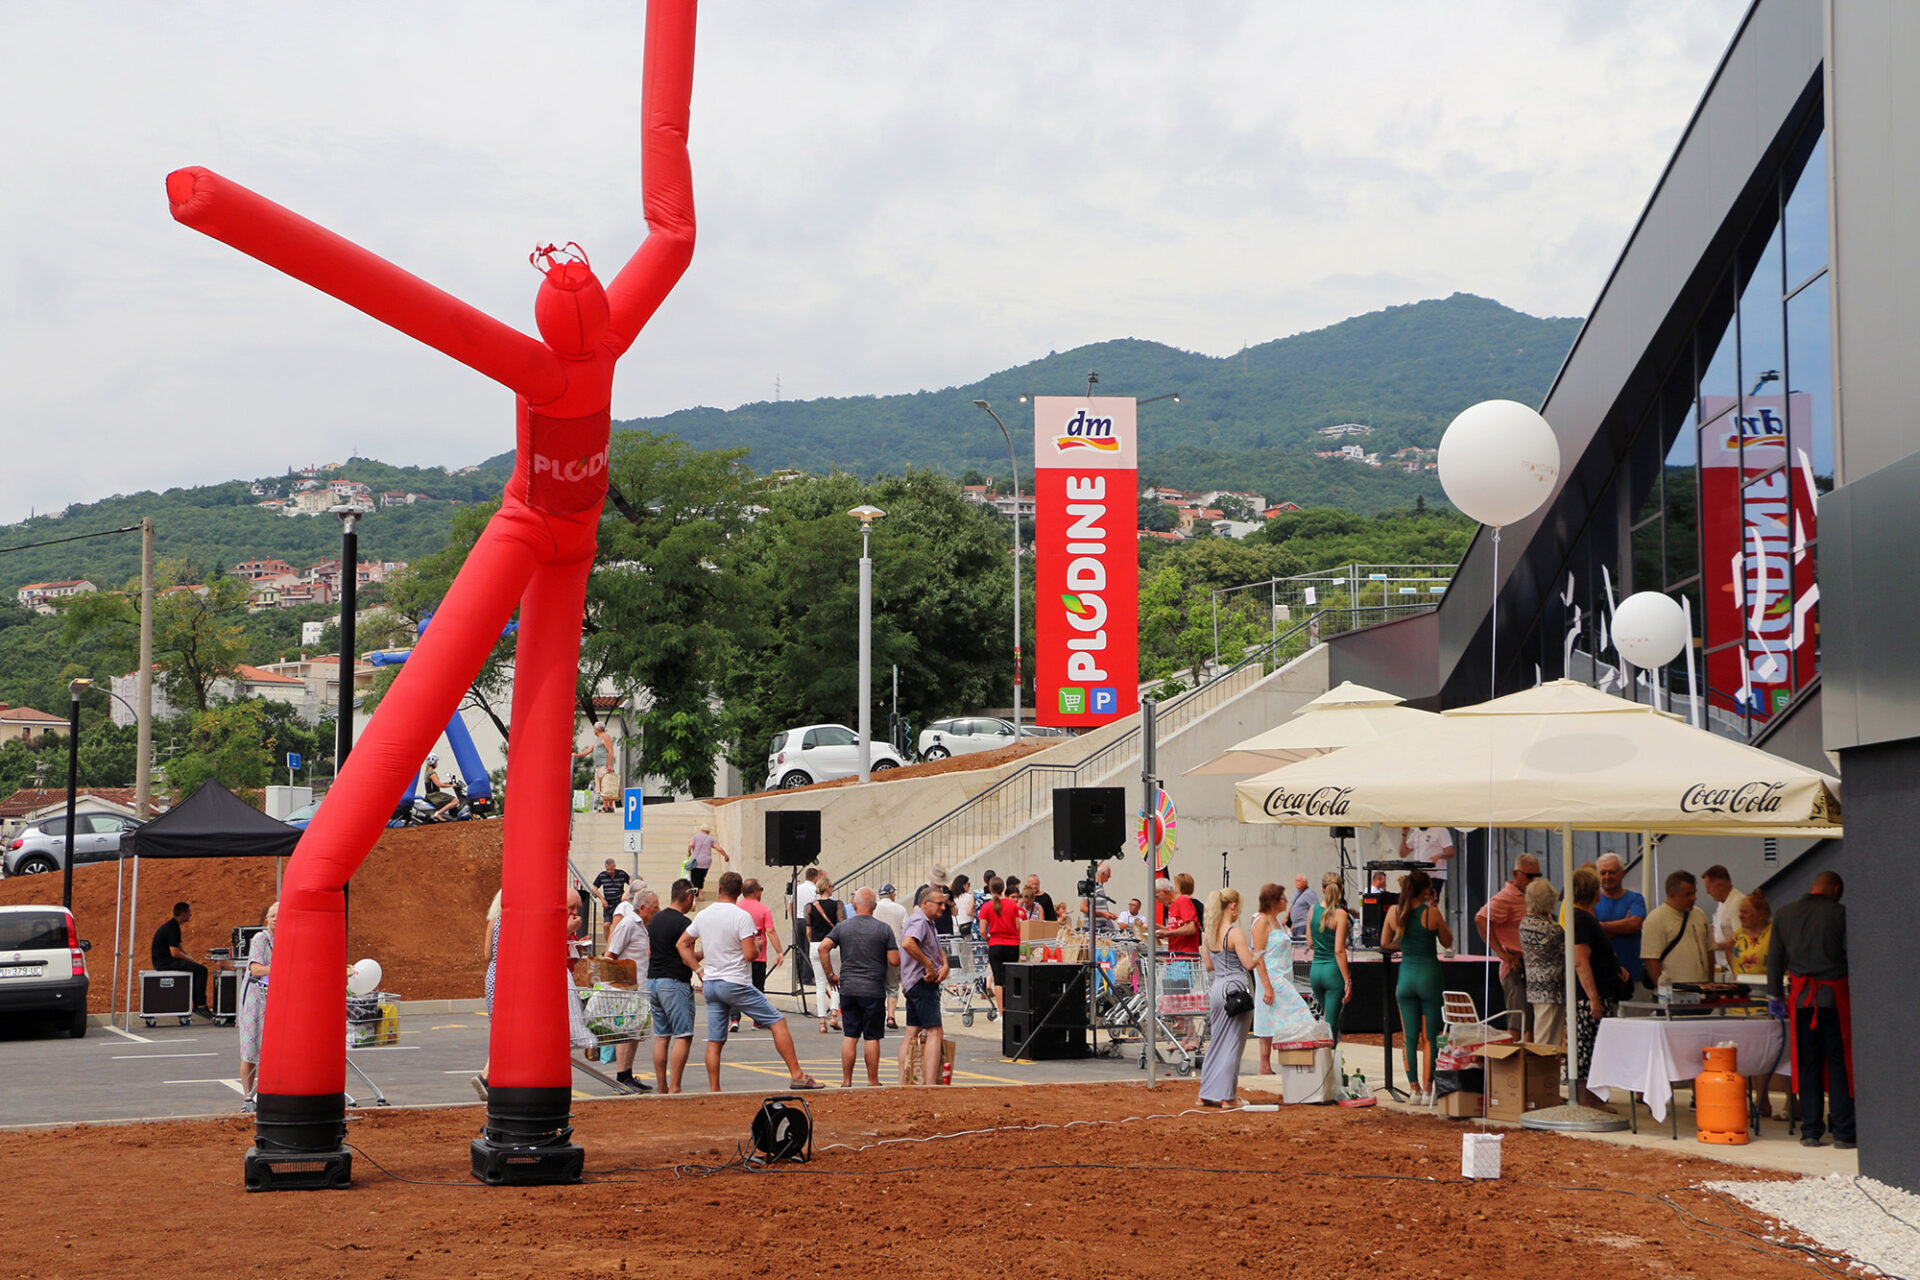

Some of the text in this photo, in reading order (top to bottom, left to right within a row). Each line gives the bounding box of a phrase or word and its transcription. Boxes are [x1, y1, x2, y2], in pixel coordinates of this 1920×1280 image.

[1067, 411, 1111, 436] dm
[1065, 475, 1108, 681] PLODINE
[1097, 692, 1111, 710] P
[628, 796, 637, 822] P
[1263, 786, 1356, 816] Coca-Cola
[1680, 781, 1788, 813] Coca-Cola
